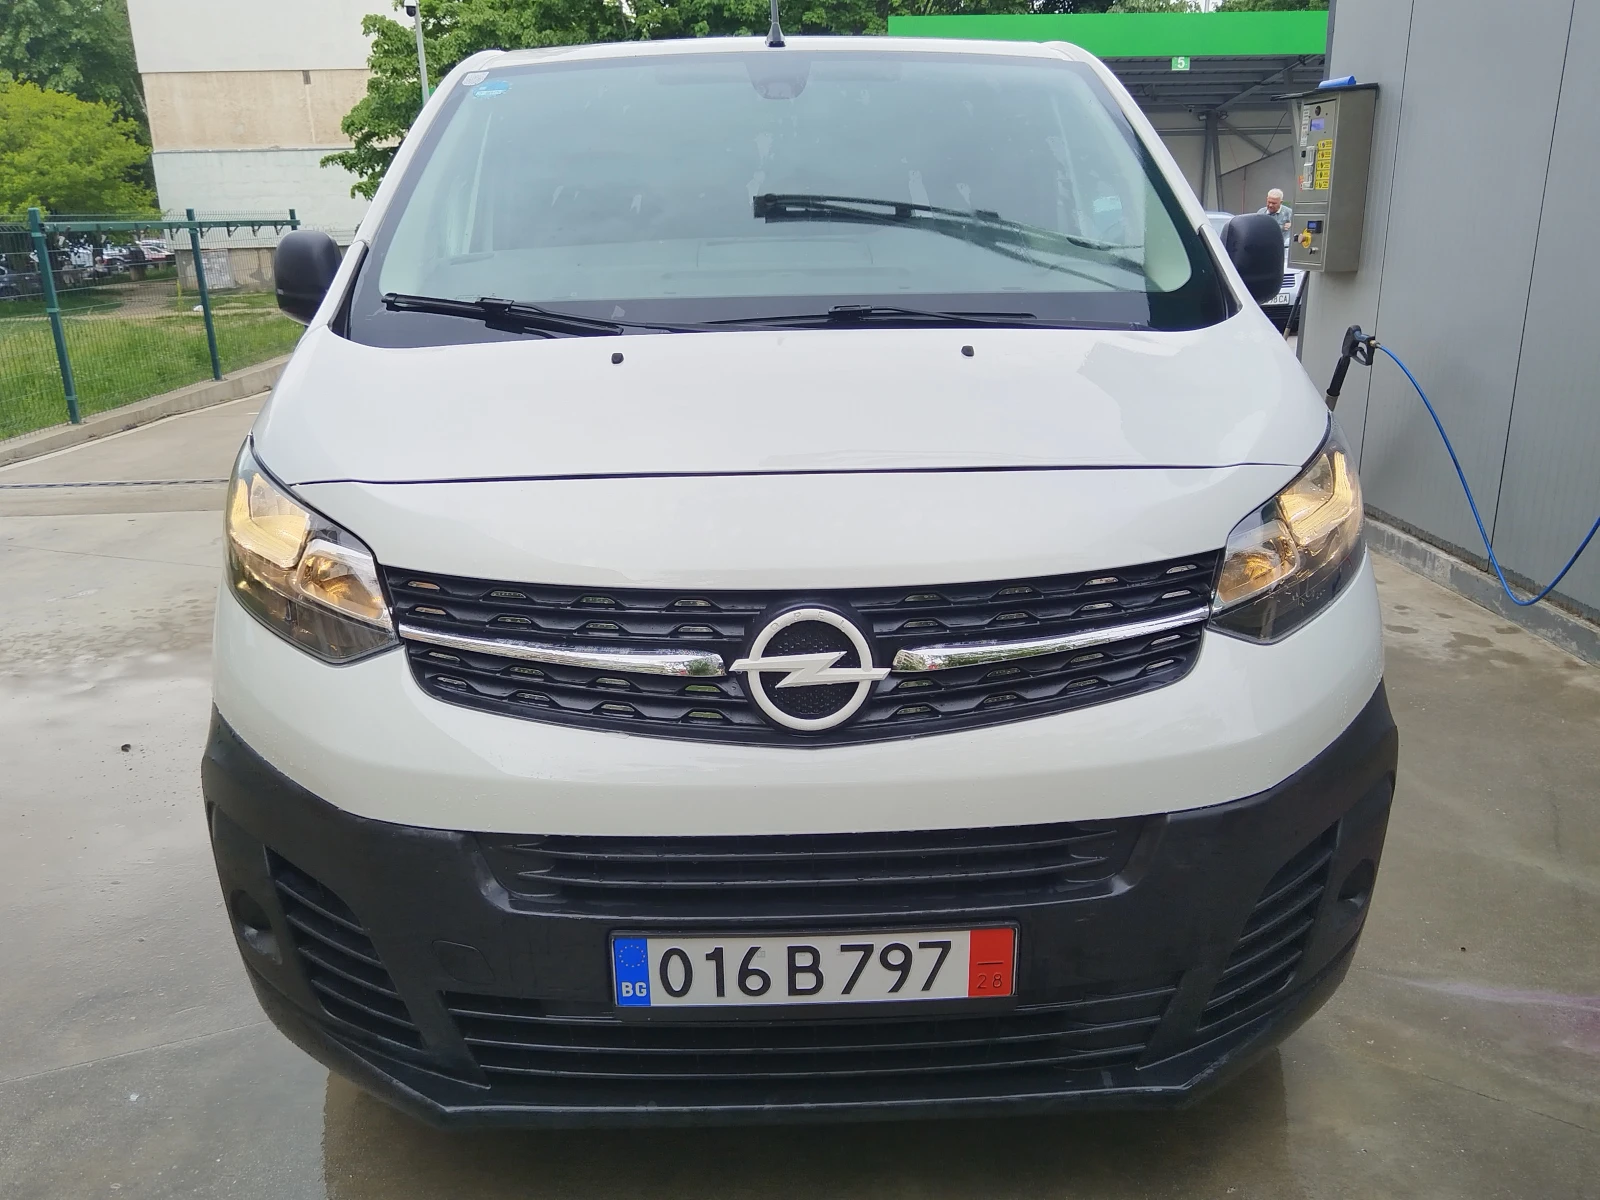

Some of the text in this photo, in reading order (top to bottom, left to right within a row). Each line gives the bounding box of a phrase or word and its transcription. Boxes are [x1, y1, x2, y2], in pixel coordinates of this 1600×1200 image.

[1177, 56, 1185, 69] 5
[769, 611, 845, 632] OPEL
[659, 940, 952, 998] 016 B 797
[621, 981, 647, 997] BG
[976, 972, 1003, 989] 28
